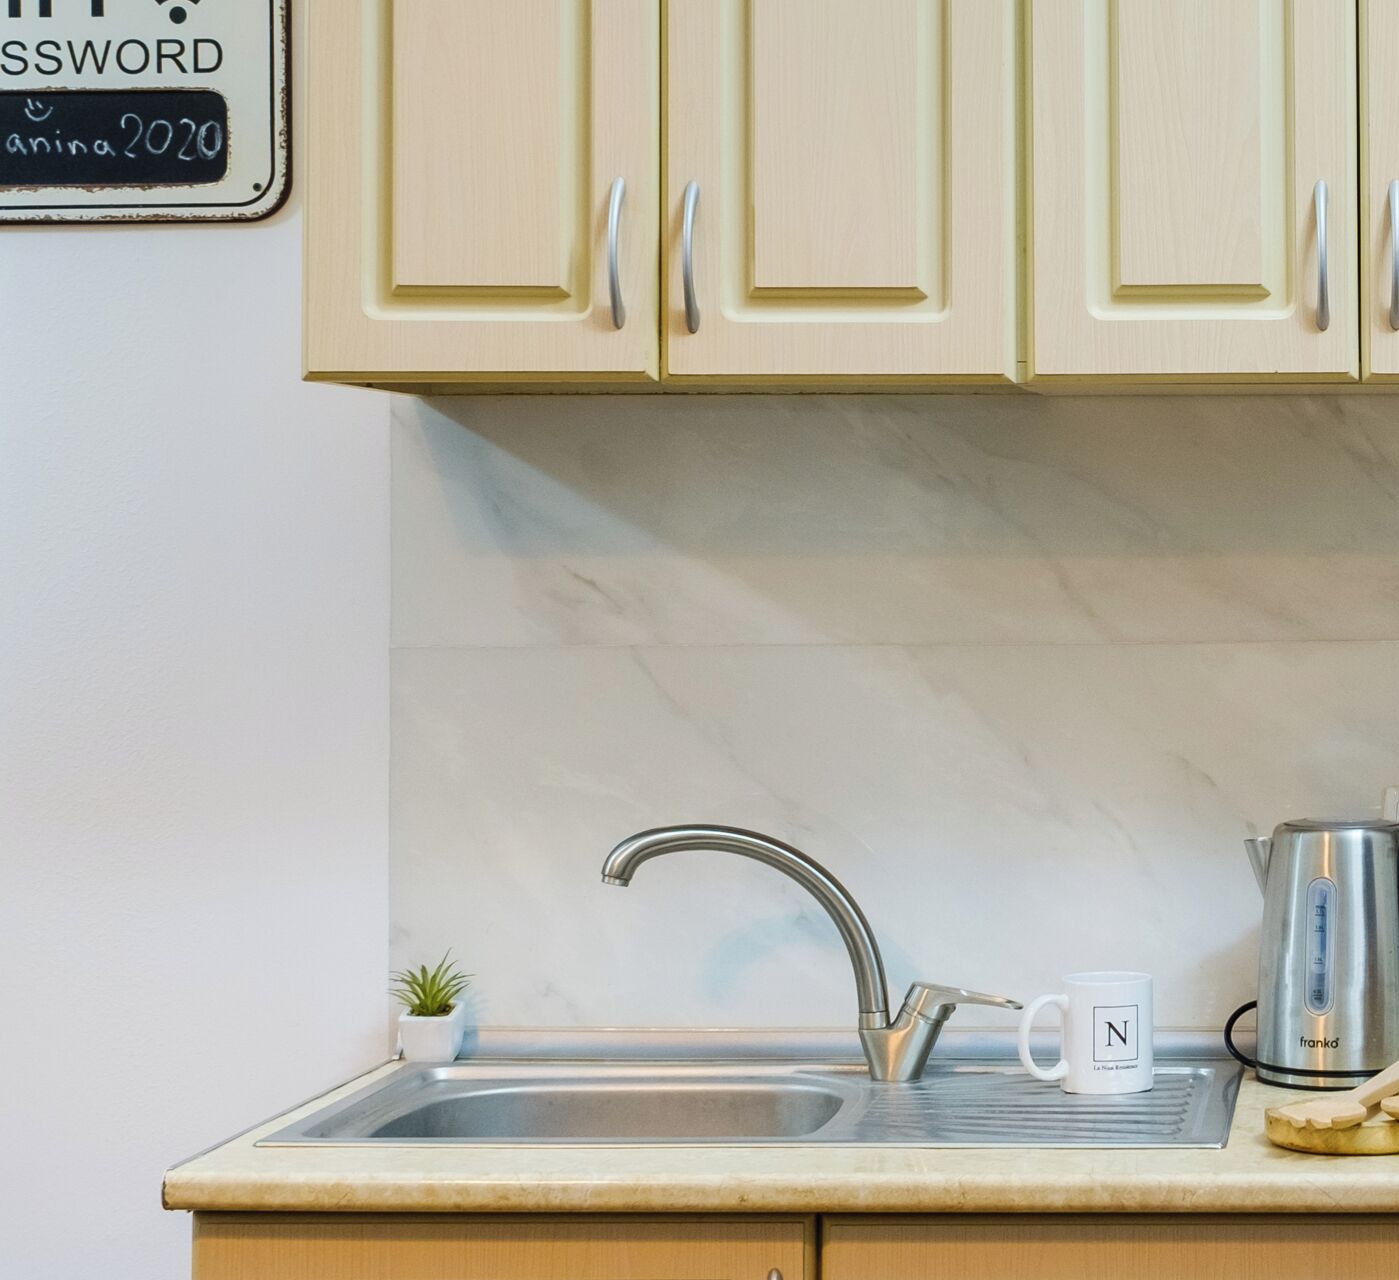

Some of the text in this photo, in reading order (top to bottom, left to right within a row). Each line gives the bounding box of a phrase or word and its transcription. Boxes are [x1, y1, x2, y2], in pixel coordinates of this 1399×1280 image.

[1, 38, 223, 75] SSWORD
[6, 113, 222, 160] anina2020
[1104, 1020, 1129, 1047] N
[1300, 1036, 1339, 1049] franko
